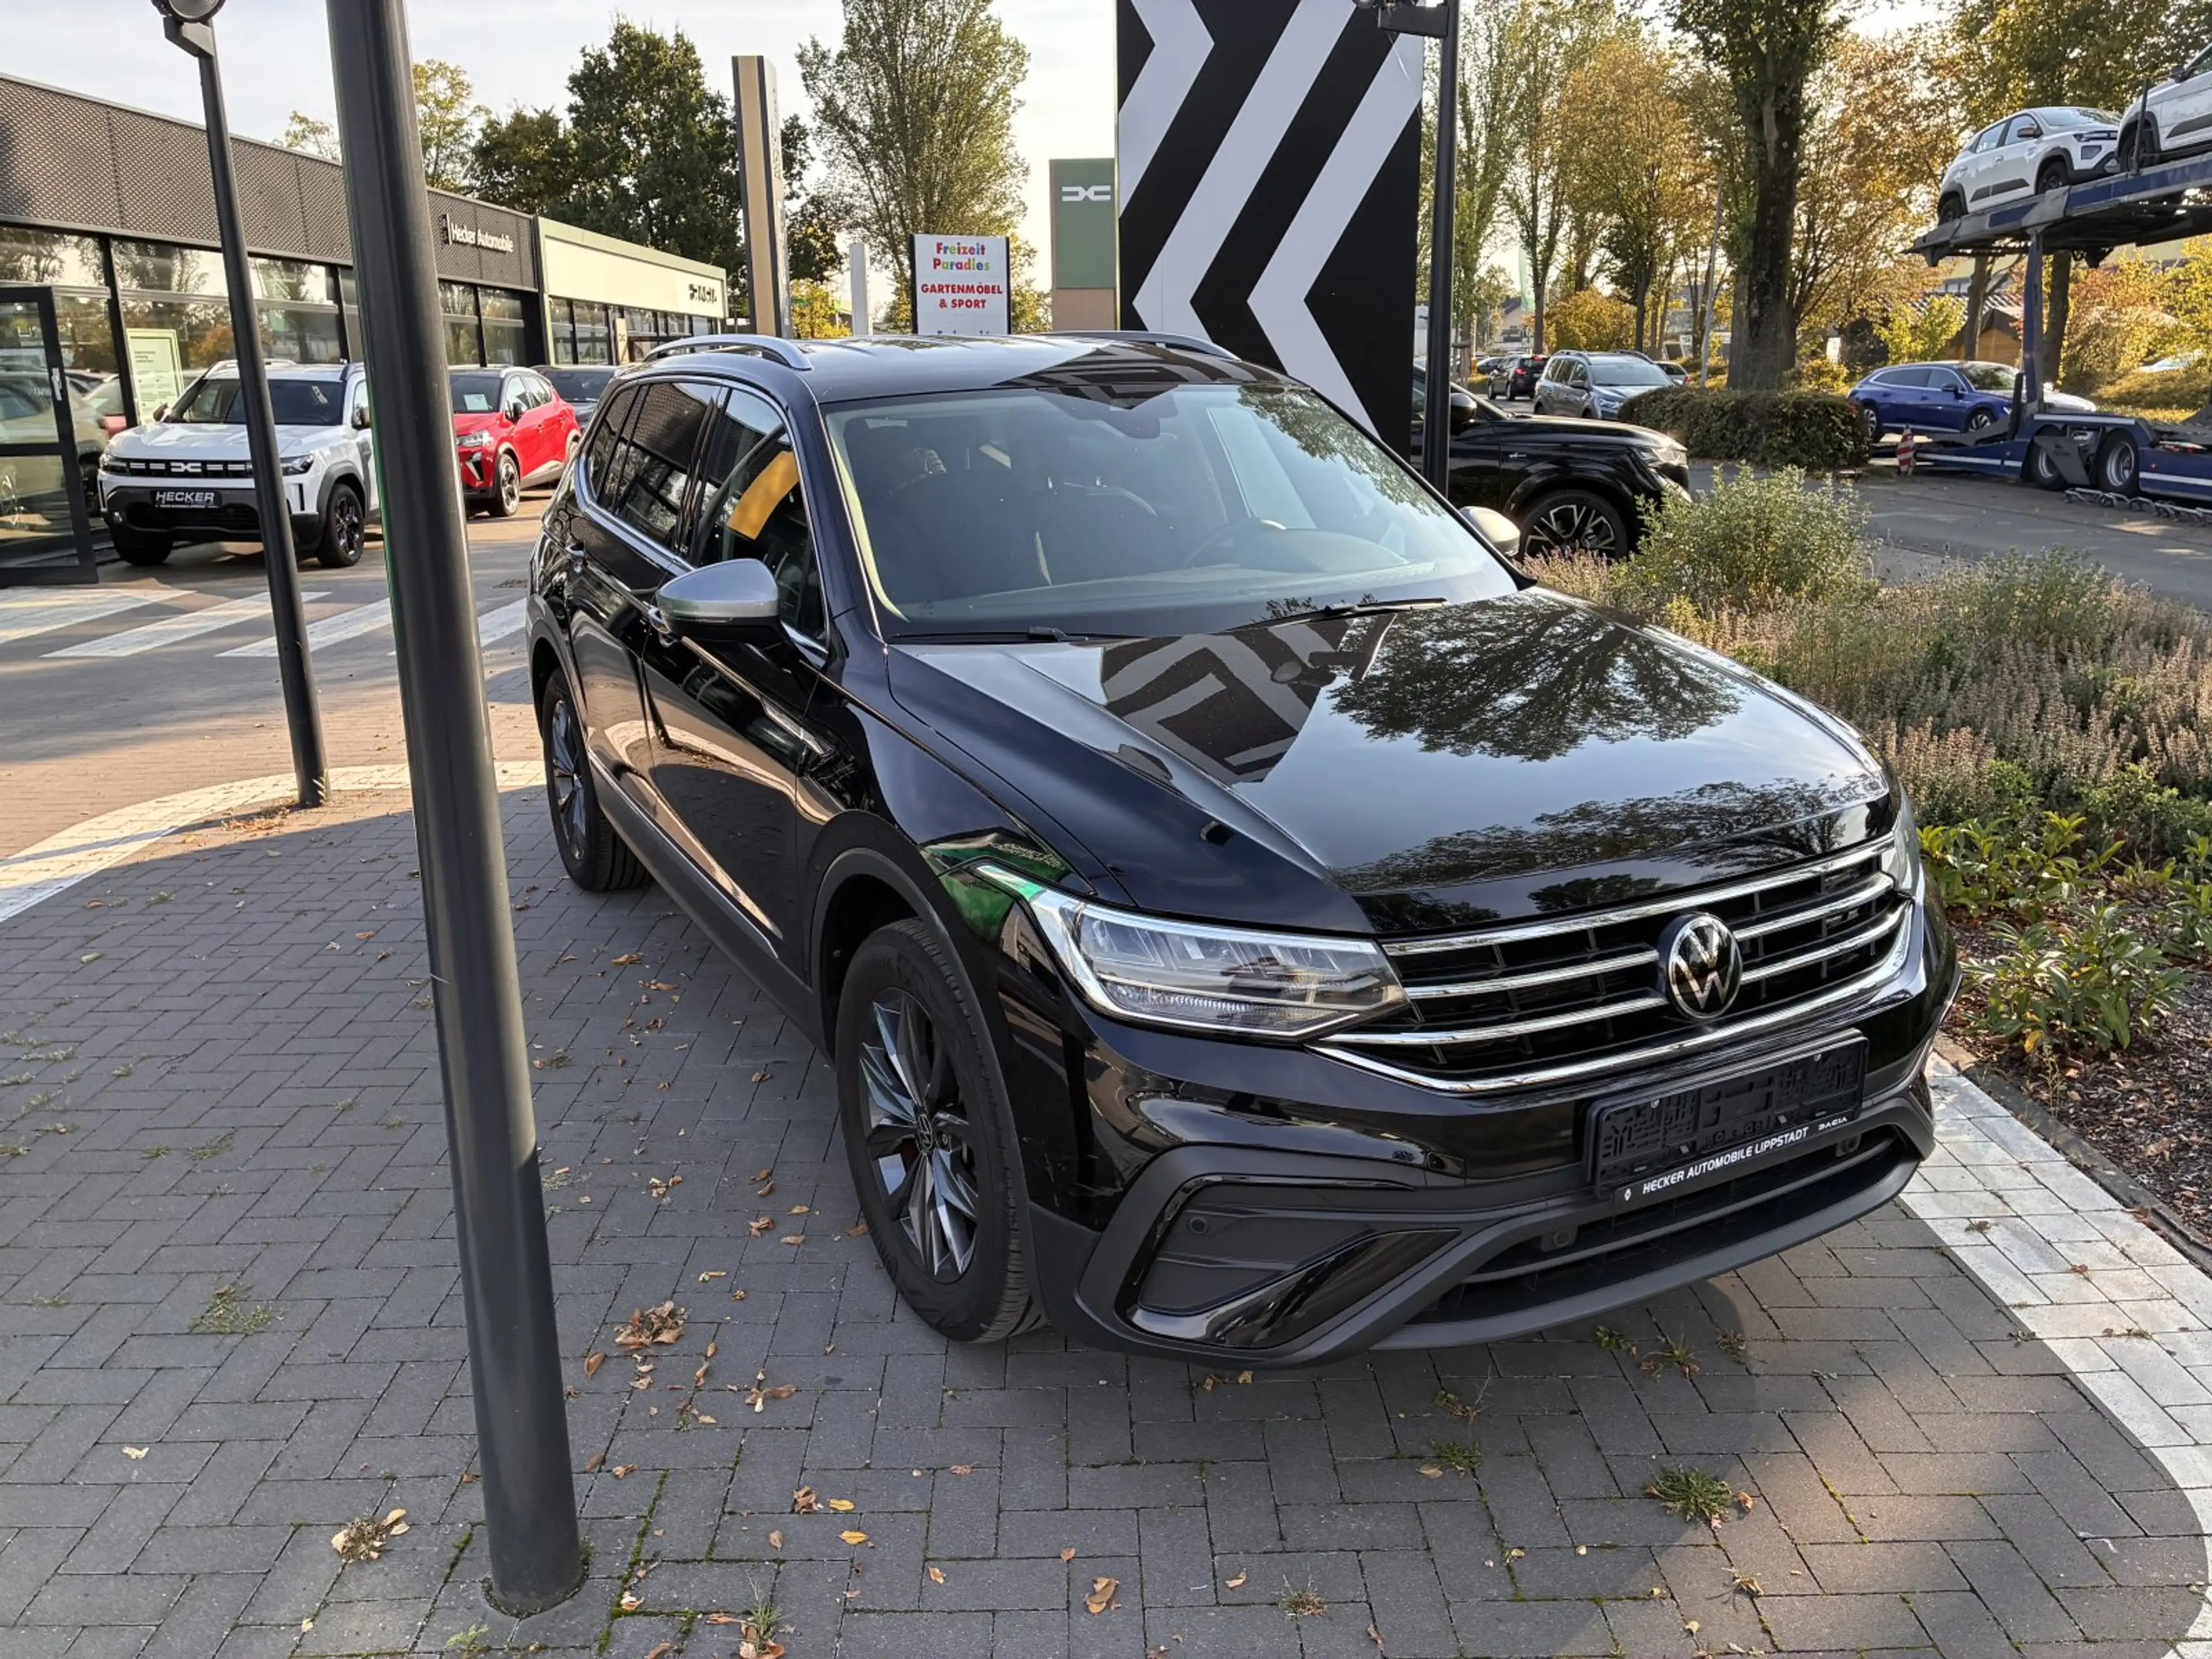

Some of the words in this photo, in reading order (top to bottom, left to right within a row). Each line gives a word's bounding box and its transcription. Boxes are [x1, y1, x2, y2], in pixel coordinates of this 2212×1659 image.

[451, 222, 476, 244] Hecker
[936, 241, 986, 255] Freizeit
[933, 258, 991, 270] Paradies
[921, 282, 1003, 294] GARTENMÖBEL
[939, 298, 948, 309] &
[951, 298, 986, 309] SPORT
[156, 490, 215, 505] HECKER
[1643, 1170, 1685, 1194] HECKER
[1687, 1145, 1753, 1179] AUTOMOBILE
[1755, 1126, 1809, 1154] LIPPSTADT
